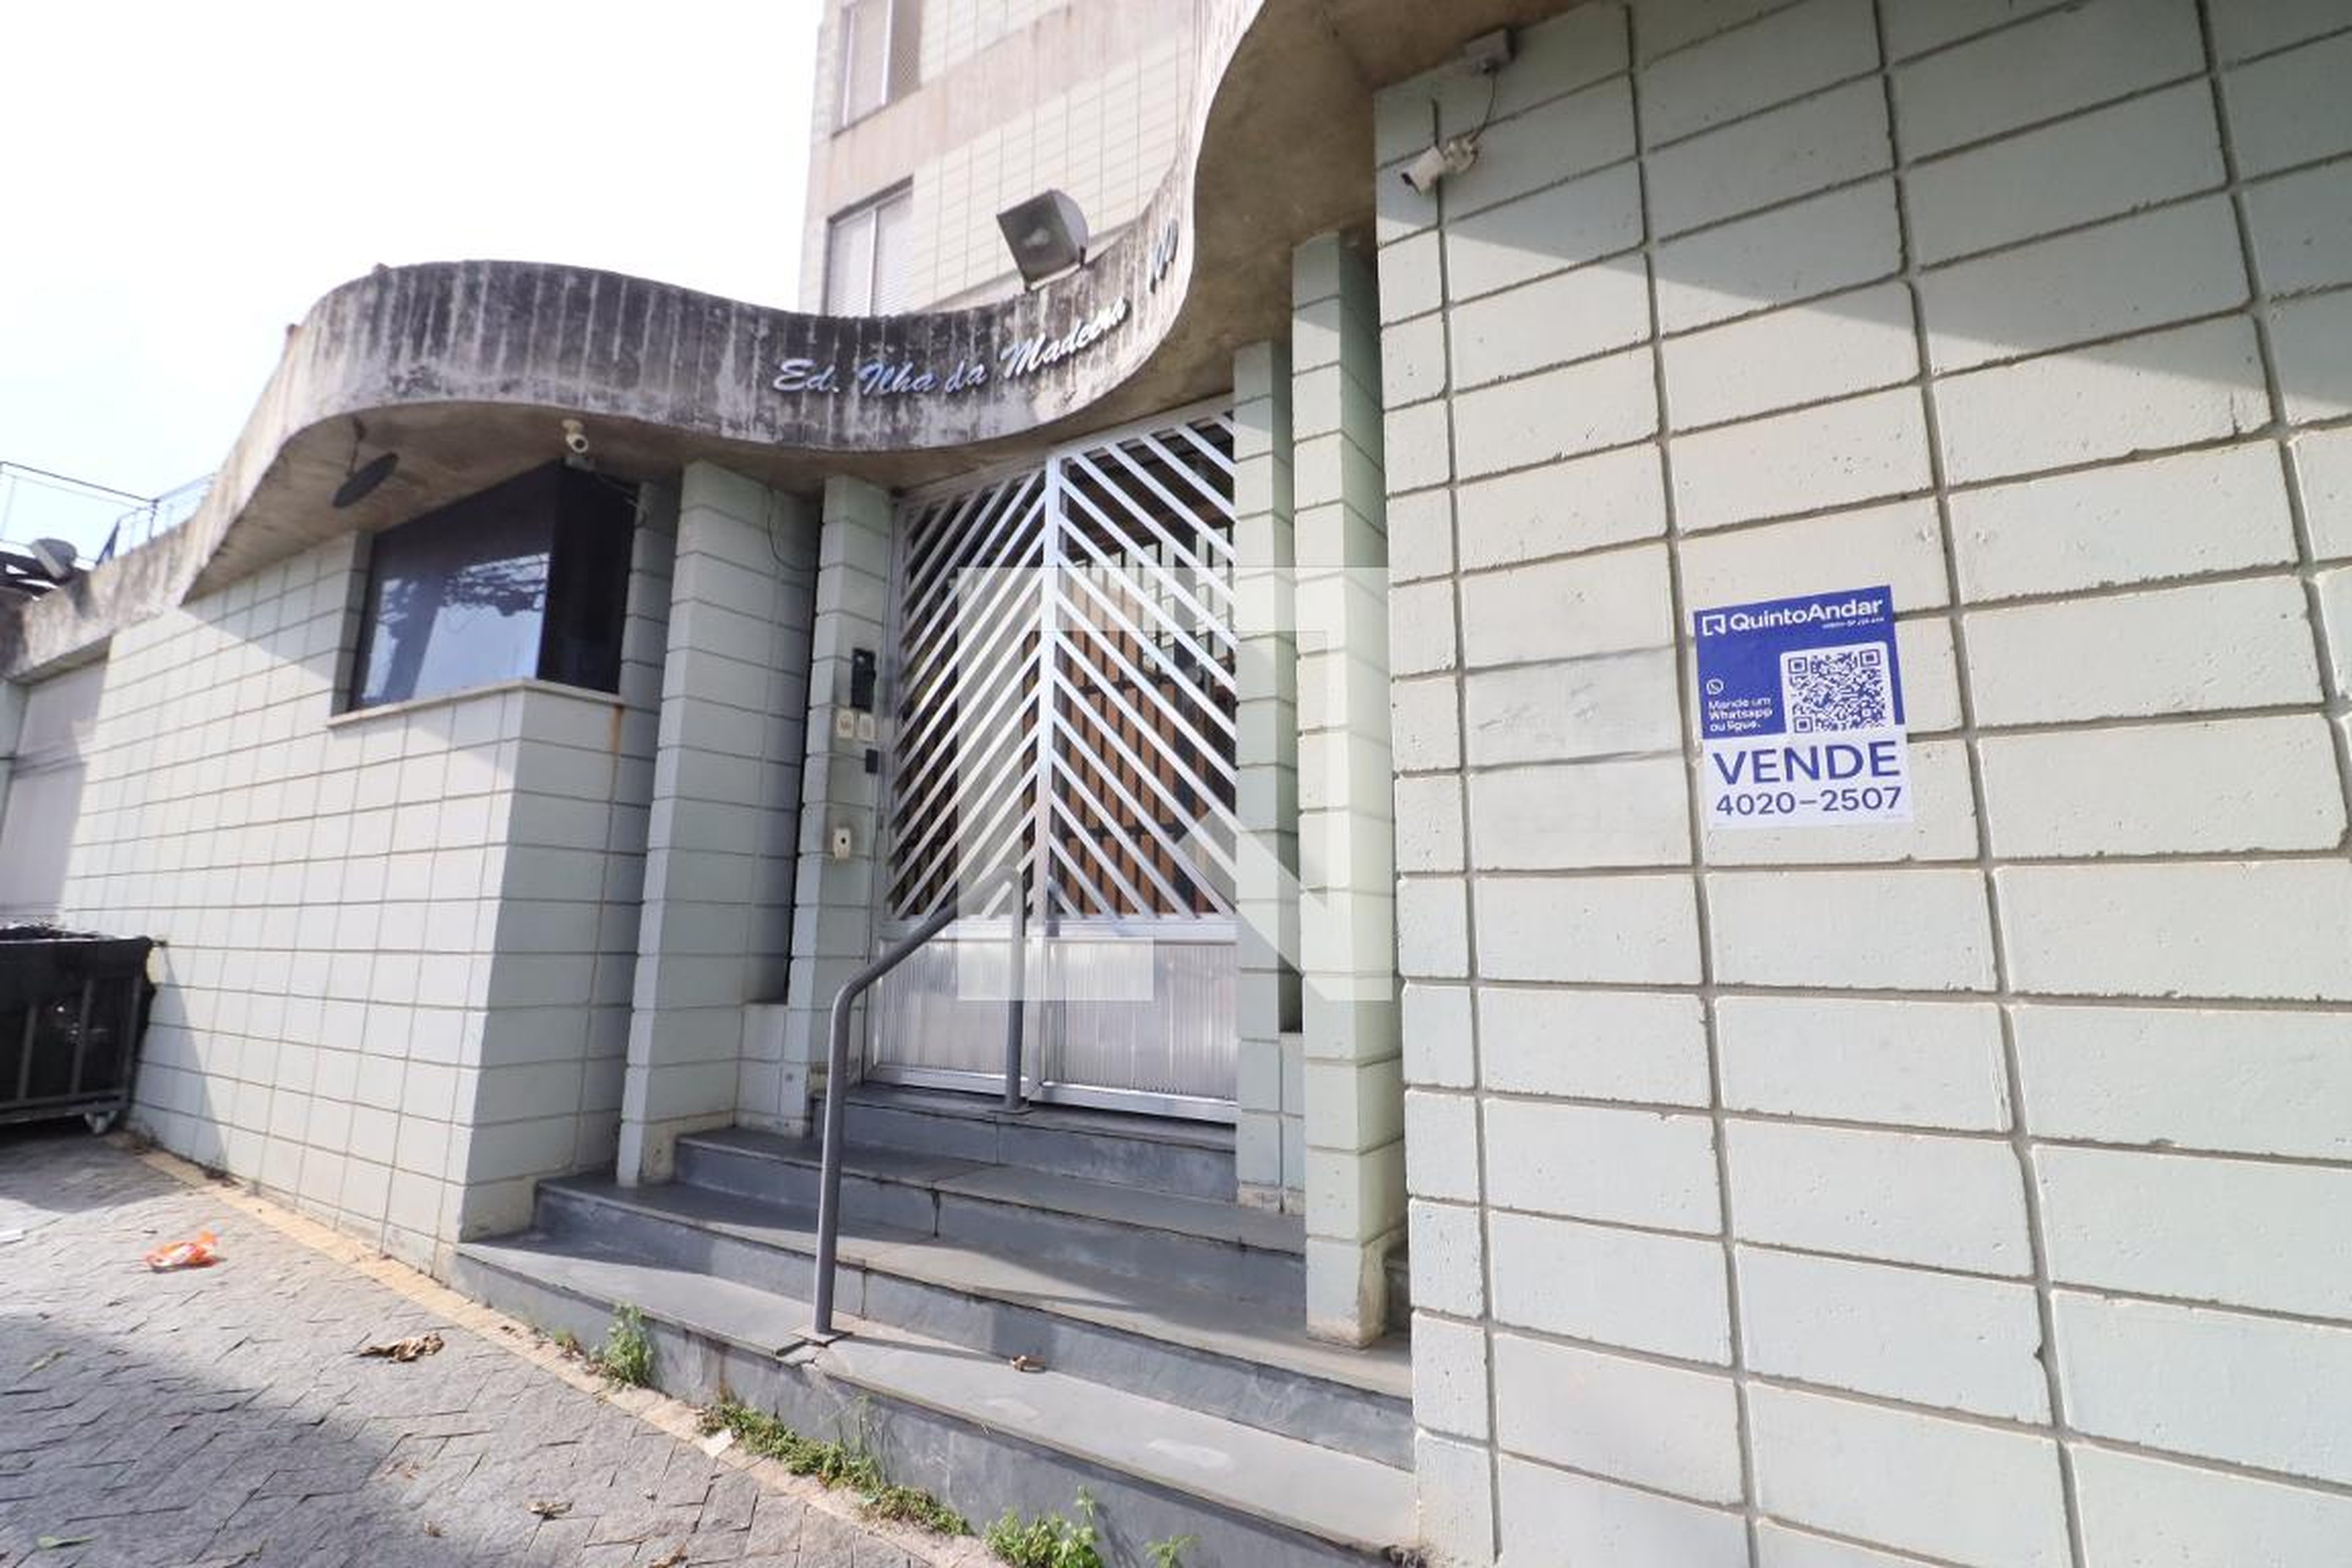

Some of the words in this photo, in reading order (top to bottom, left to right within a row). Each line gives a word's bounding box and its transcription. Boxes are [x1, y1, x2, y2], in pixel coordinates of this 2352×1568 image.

[773, 358, 840, 393] Ed.
[859, 358, 938, 395] Ilha
[945, 359, 987, 393] da
[1730, 598, 1883, 631] QuintoAndar
[1752, 698, 1771, 707] um
[1710, 723, 1726, 732] ou
[1713, 741, 1900, 785] VENDE
[1716, 786, 1902, 816] 4020-2507
